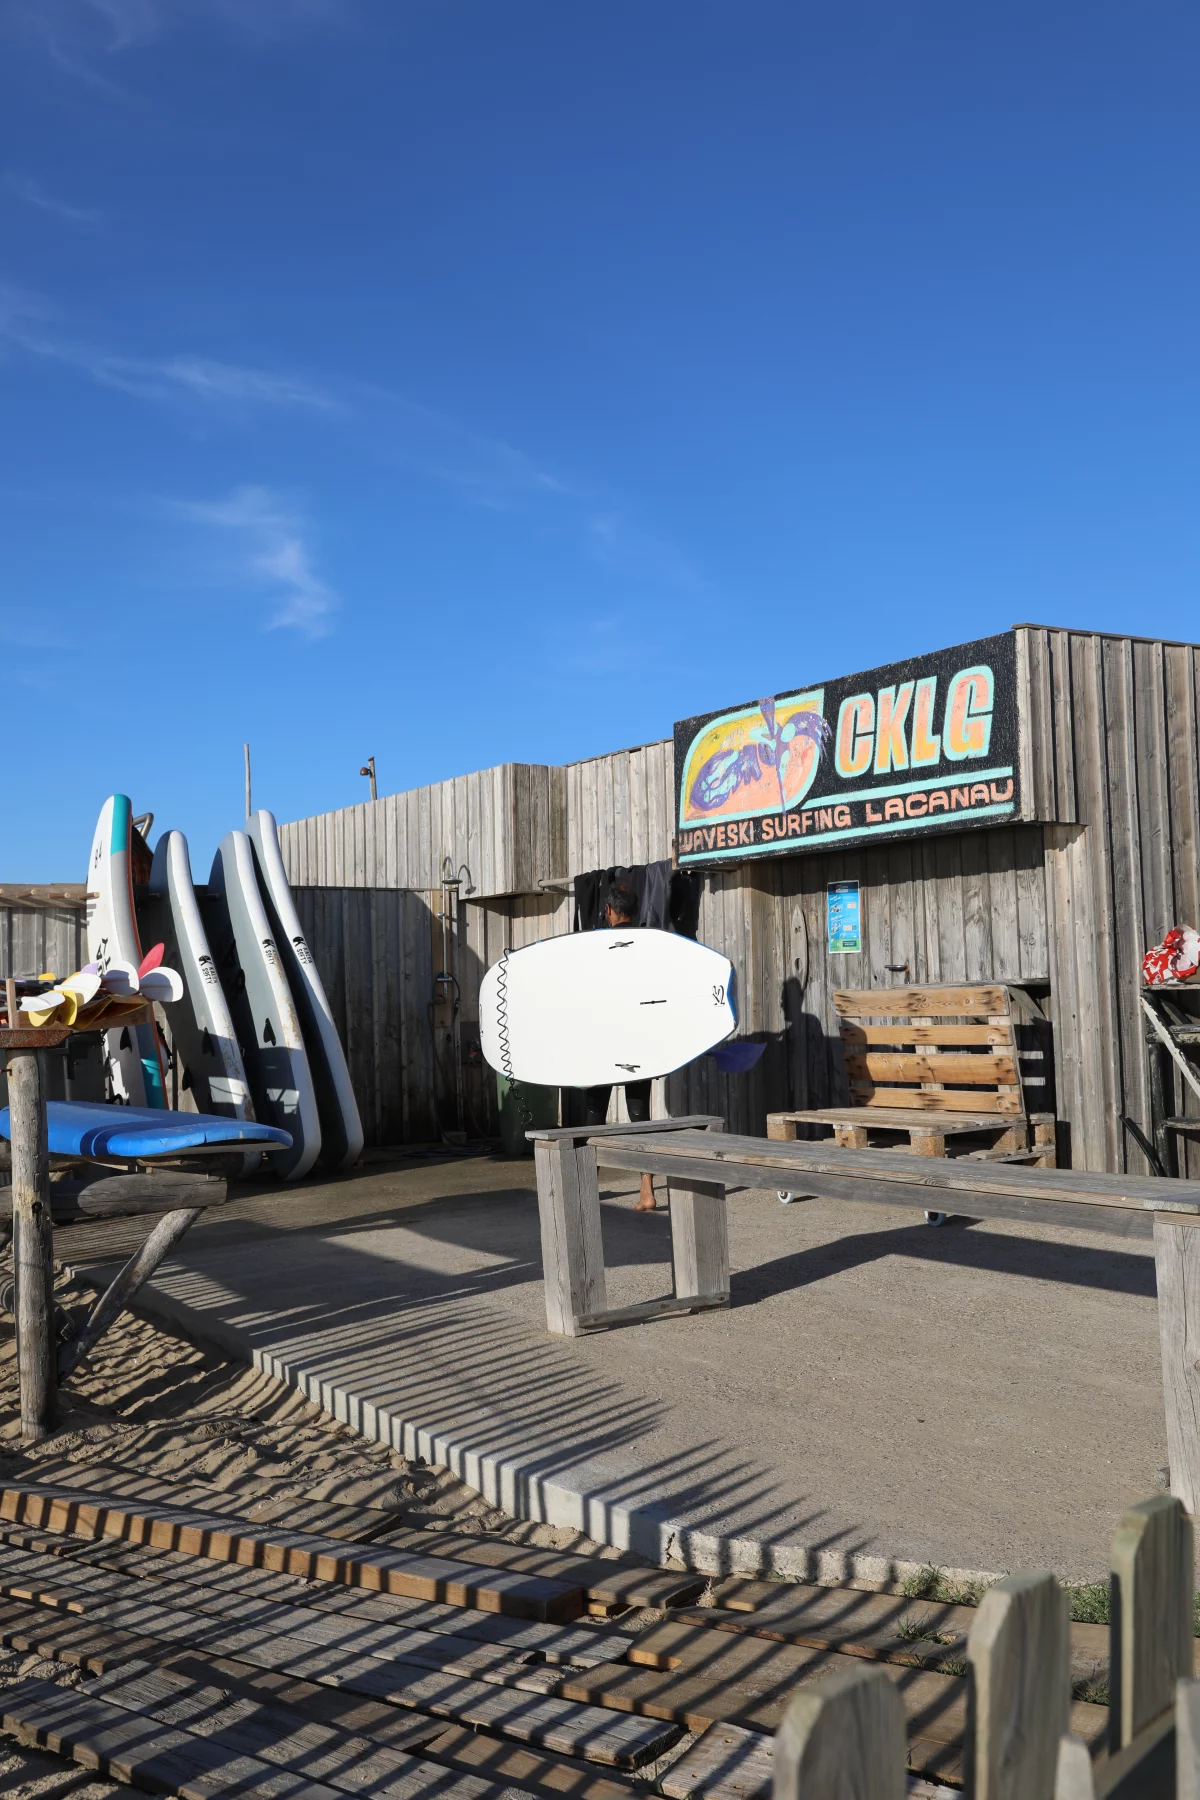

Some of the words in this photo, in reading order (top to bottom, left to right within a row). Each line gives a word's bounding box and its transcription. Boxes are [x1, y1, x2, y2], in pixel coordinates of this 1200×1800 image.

[835, 665, 994, 778] CKLG
[679, 820, 754, 852] WAVESKI
[761, 805, 851, 840] SURFING
[865, 778, 1014, 823] LACANAU
